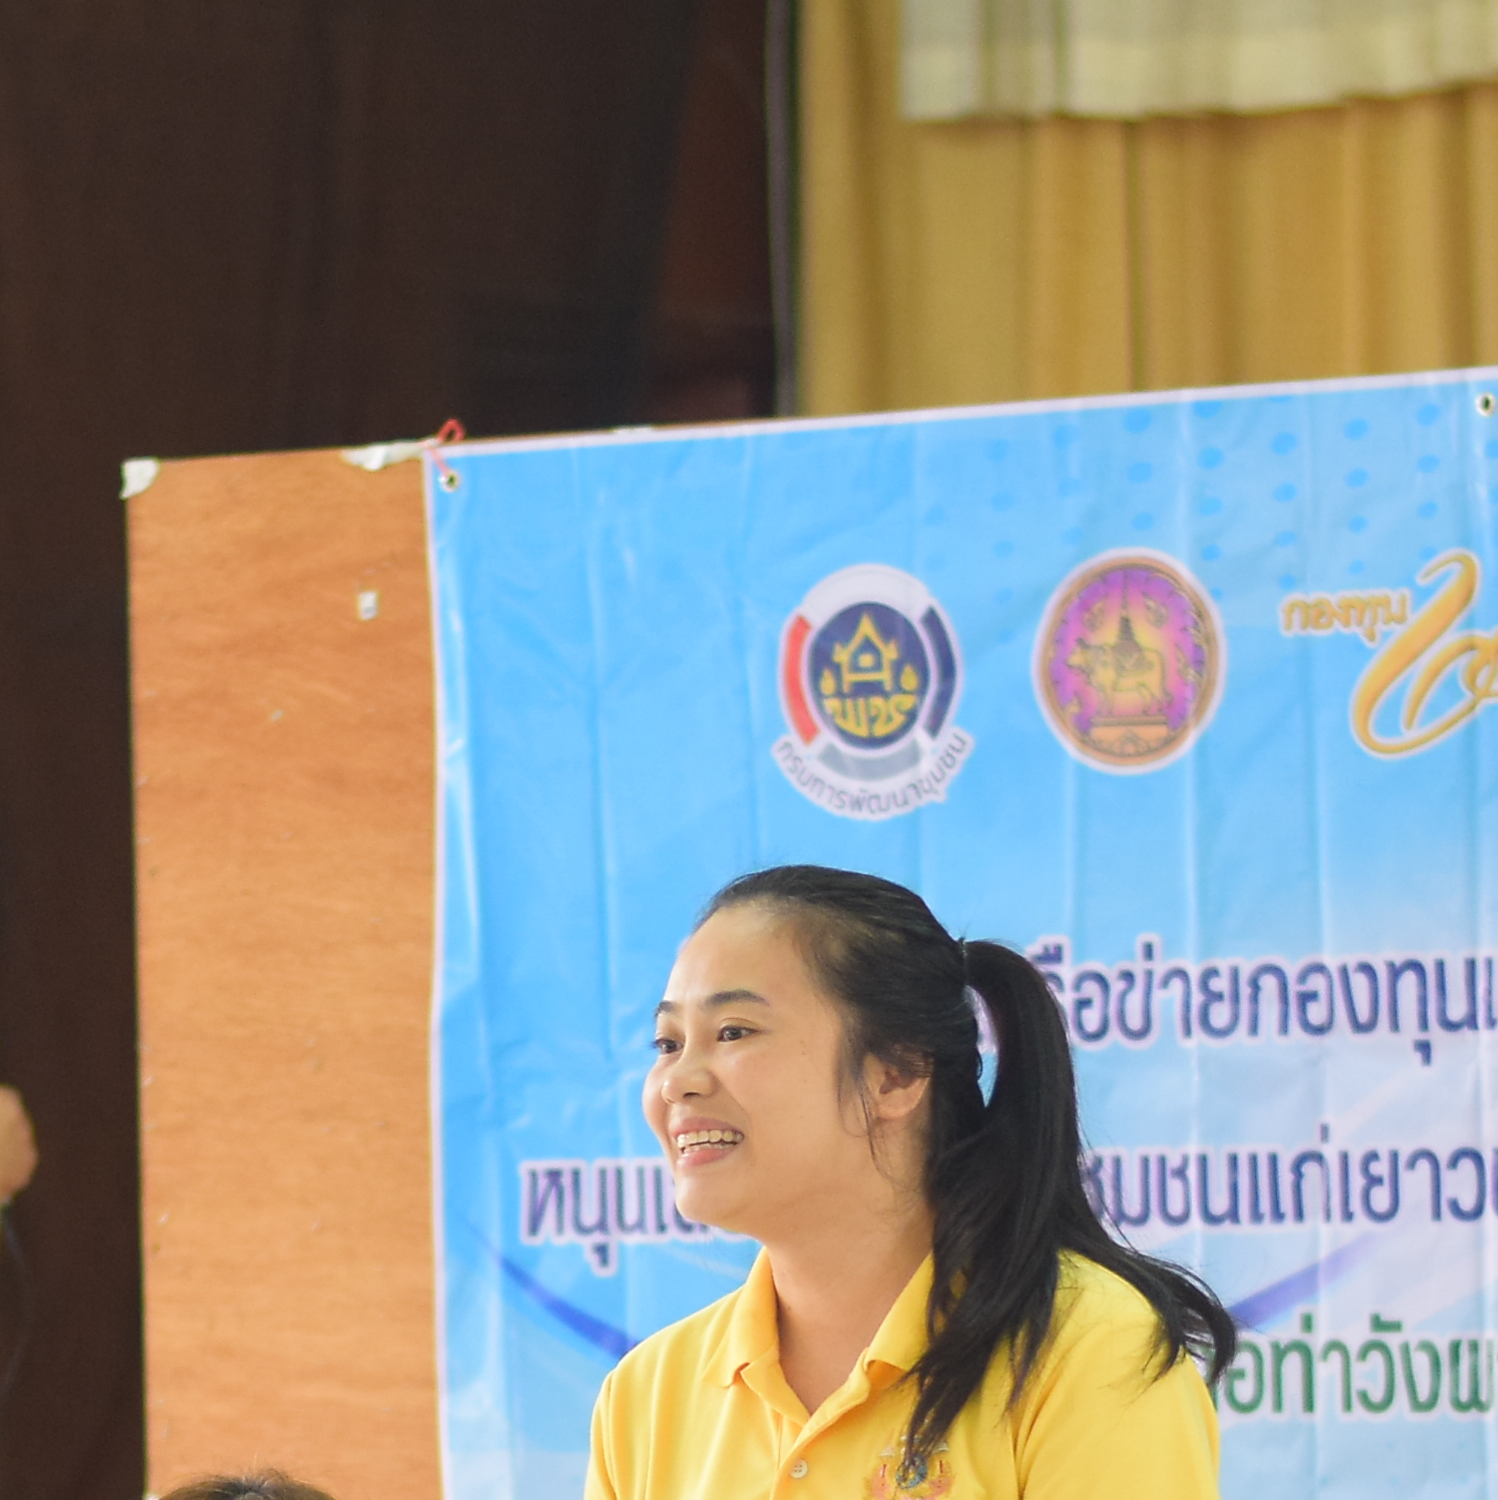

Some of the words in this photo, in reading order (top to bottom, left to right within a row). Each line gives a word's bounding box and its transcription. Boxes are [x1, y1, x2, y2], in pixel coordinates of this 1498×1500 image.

[1283, 594, 1407, 643] กองทุน
[776, 732, 968, 815] กรมการพัฒนาชุมชน
[528, 1166, 709, 1268] หนุนเ
